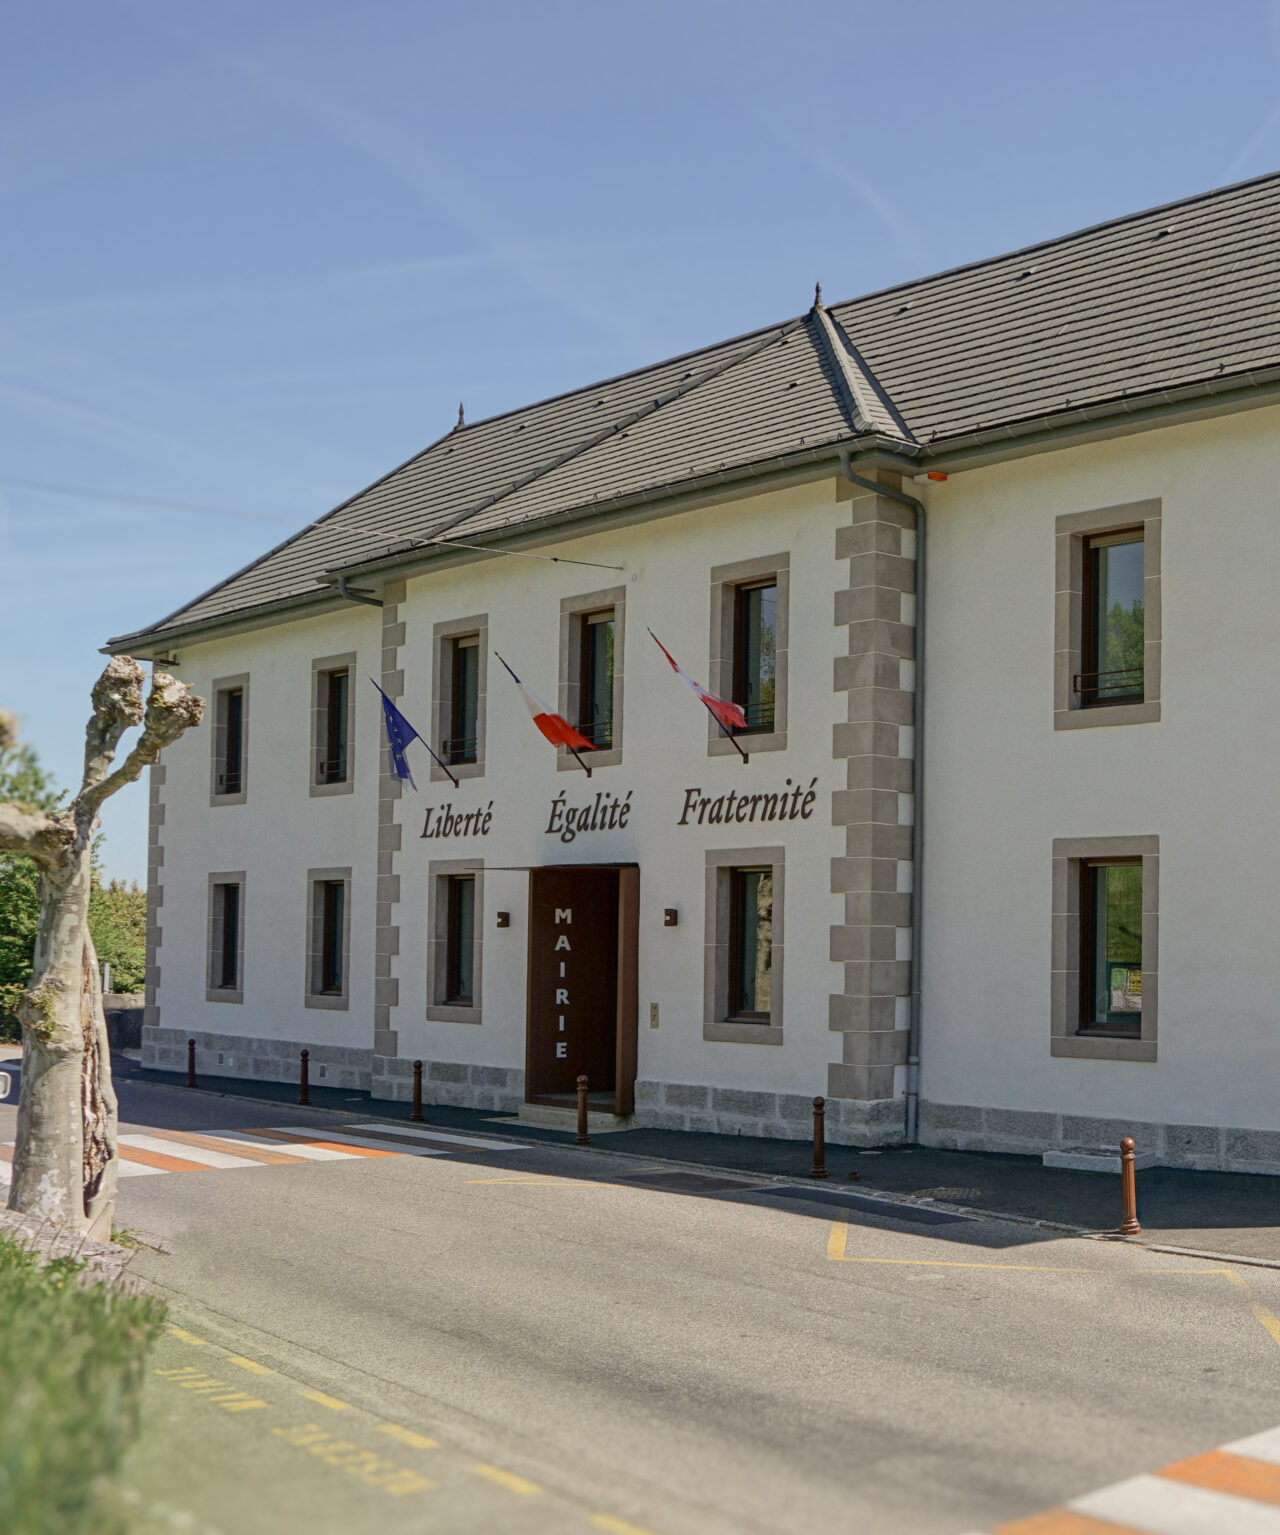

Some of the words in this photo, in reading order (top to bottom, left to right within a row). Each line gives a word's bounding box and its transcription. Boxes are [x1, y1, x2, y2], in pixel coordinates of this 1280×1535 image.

[420, 801, 494, 839] Liberté
[544, 790, 634, 843] Égalité
[677, 777, 818, 826] Fraternité
[554, 907, 573, 1060] MAIRIE
